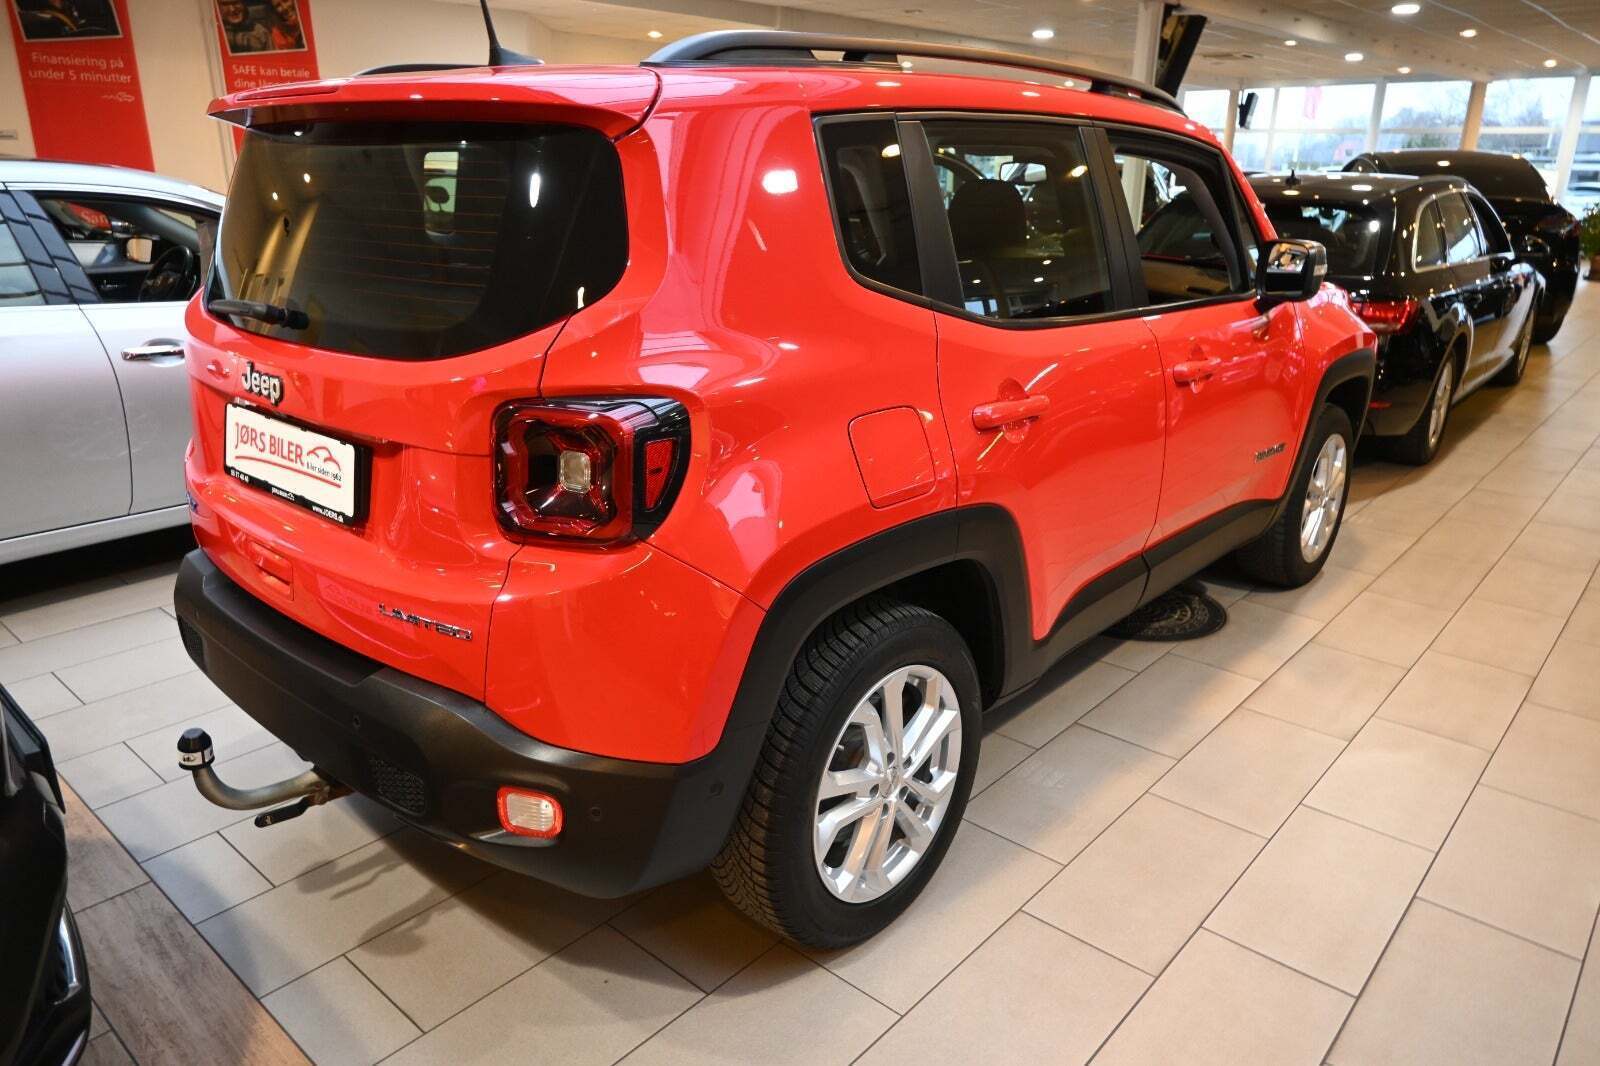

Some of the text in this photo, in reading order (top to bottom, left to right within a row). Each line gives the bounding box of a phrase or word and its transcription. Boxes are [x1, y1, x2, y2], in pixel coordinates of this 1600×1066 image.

[31, 52, 125, 69] Finansiering på
[28, 68, 132, 84] under 5 minutter
[232, 64, 311, 79] SAFE kan betale
[241, 361, 285, 406] Jeep
[234, 421, 305, 467] JØRS BILER
